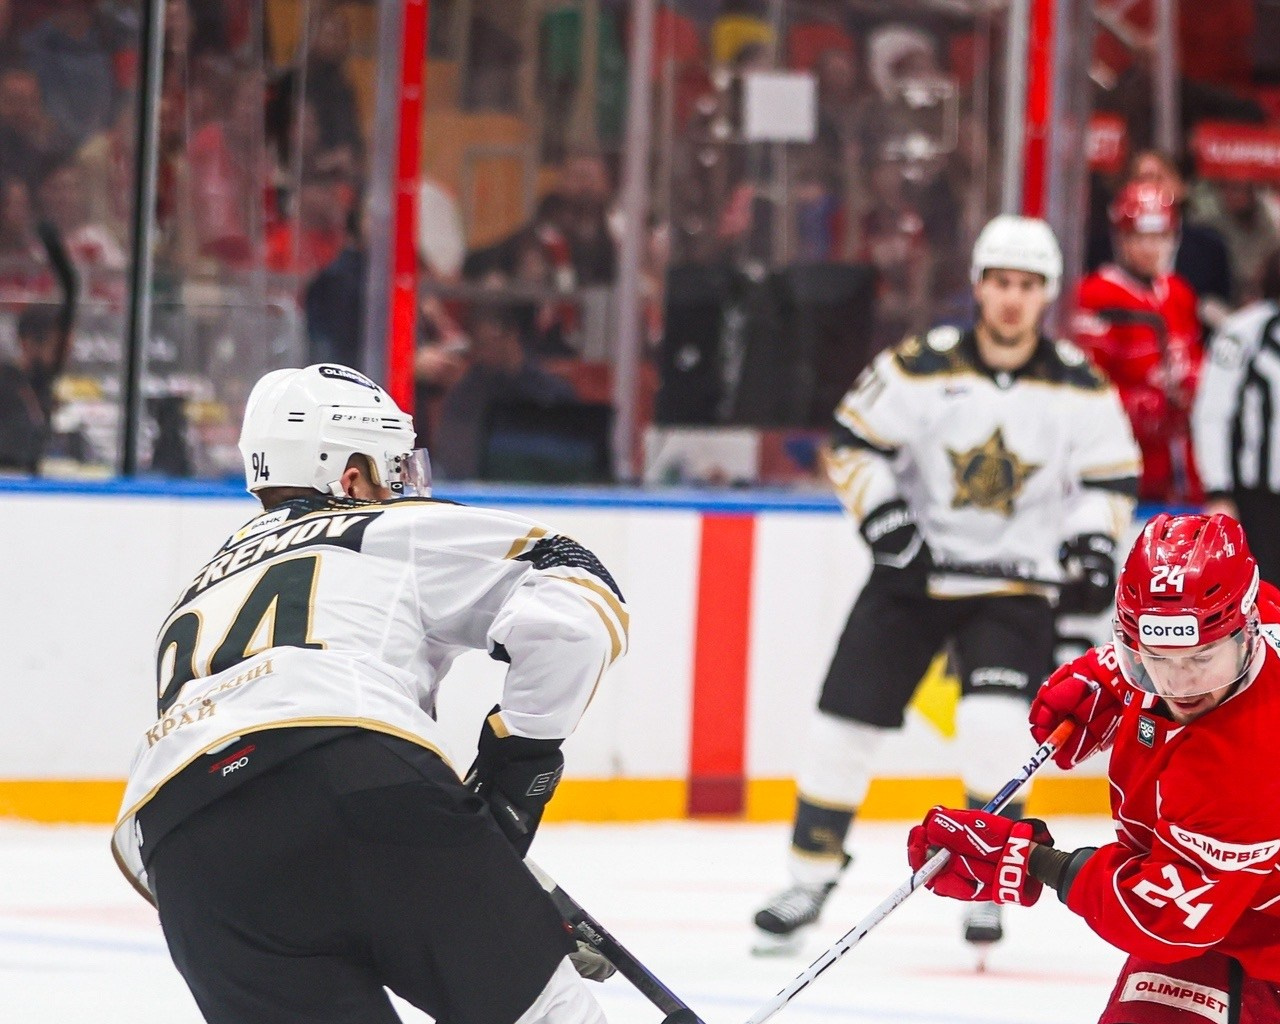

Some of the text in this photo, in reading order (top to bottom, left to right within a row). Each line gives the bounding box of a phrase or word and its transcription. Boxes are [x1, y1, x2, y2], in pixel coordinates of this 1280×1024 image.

[252, 452, 270, 482] 94
[1150, 564, 1185, 593] 24
[1142, 624, 1196, 637] согаз
[222, 756, 249, 777] PRO
[1178, 832, 1275, 863] OLIMPBET
[1131, 863, 1215, 930] 24
[1135, 981, 1228, 1014] OLIMPBET
